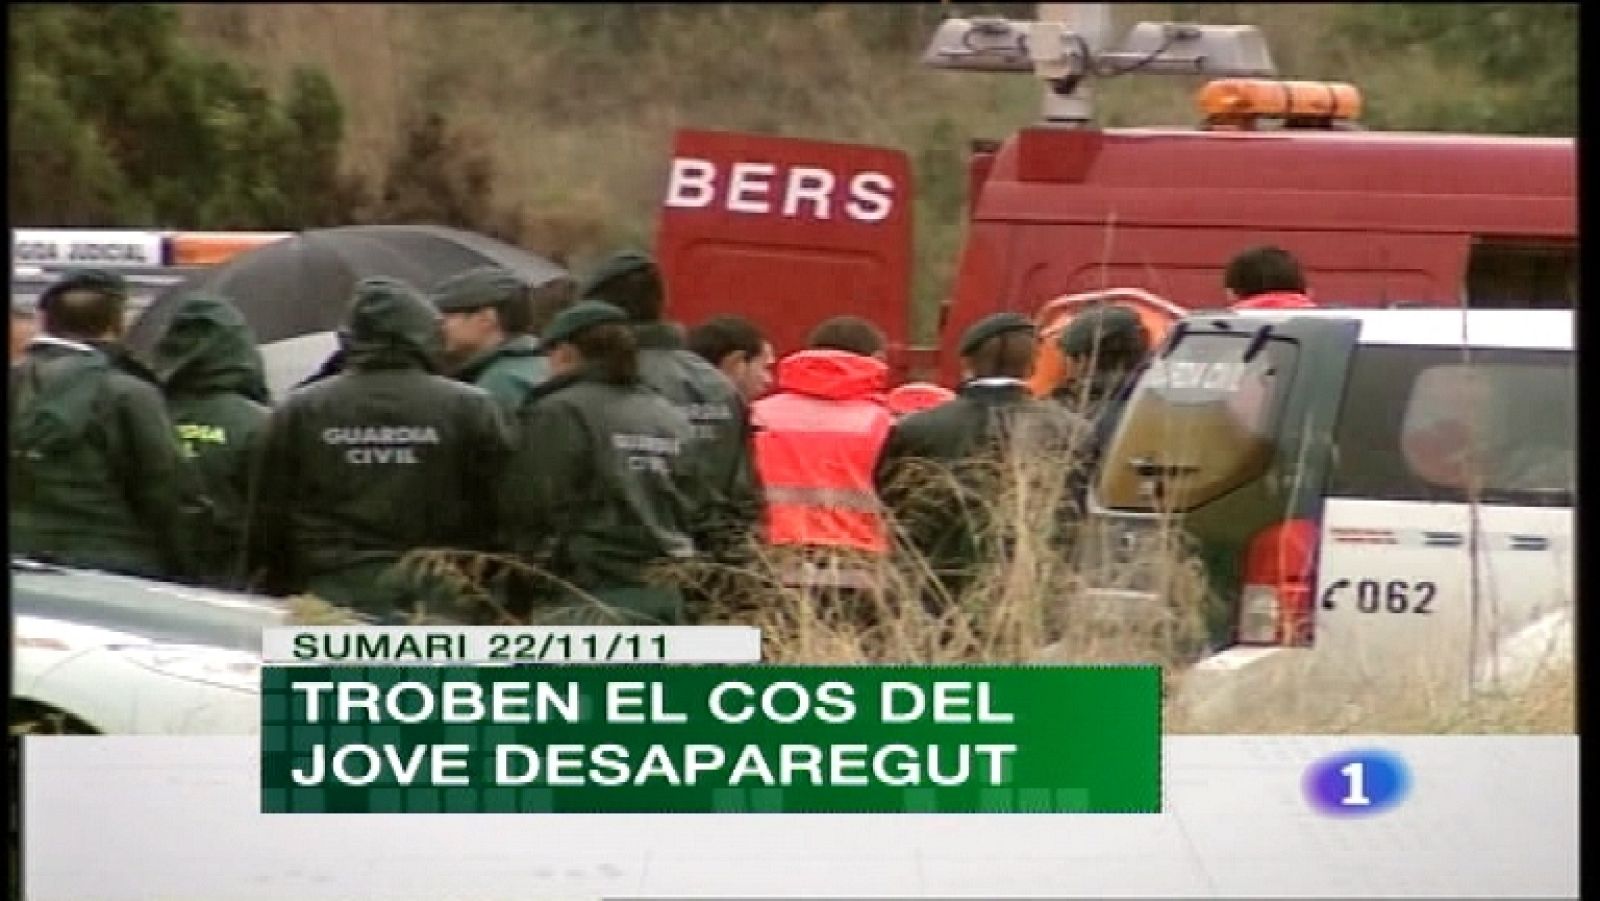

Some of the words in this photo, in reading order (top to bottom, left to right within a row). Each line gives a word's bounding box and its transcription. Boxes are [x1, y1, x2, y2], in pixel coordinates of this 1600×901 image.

[664, 157, 896, 221] BERS
[322, 426, 440, 444] GUARDIA
[346, 448, 422, 465] CIVIL
[1356, 580, 1438, 614] 062
